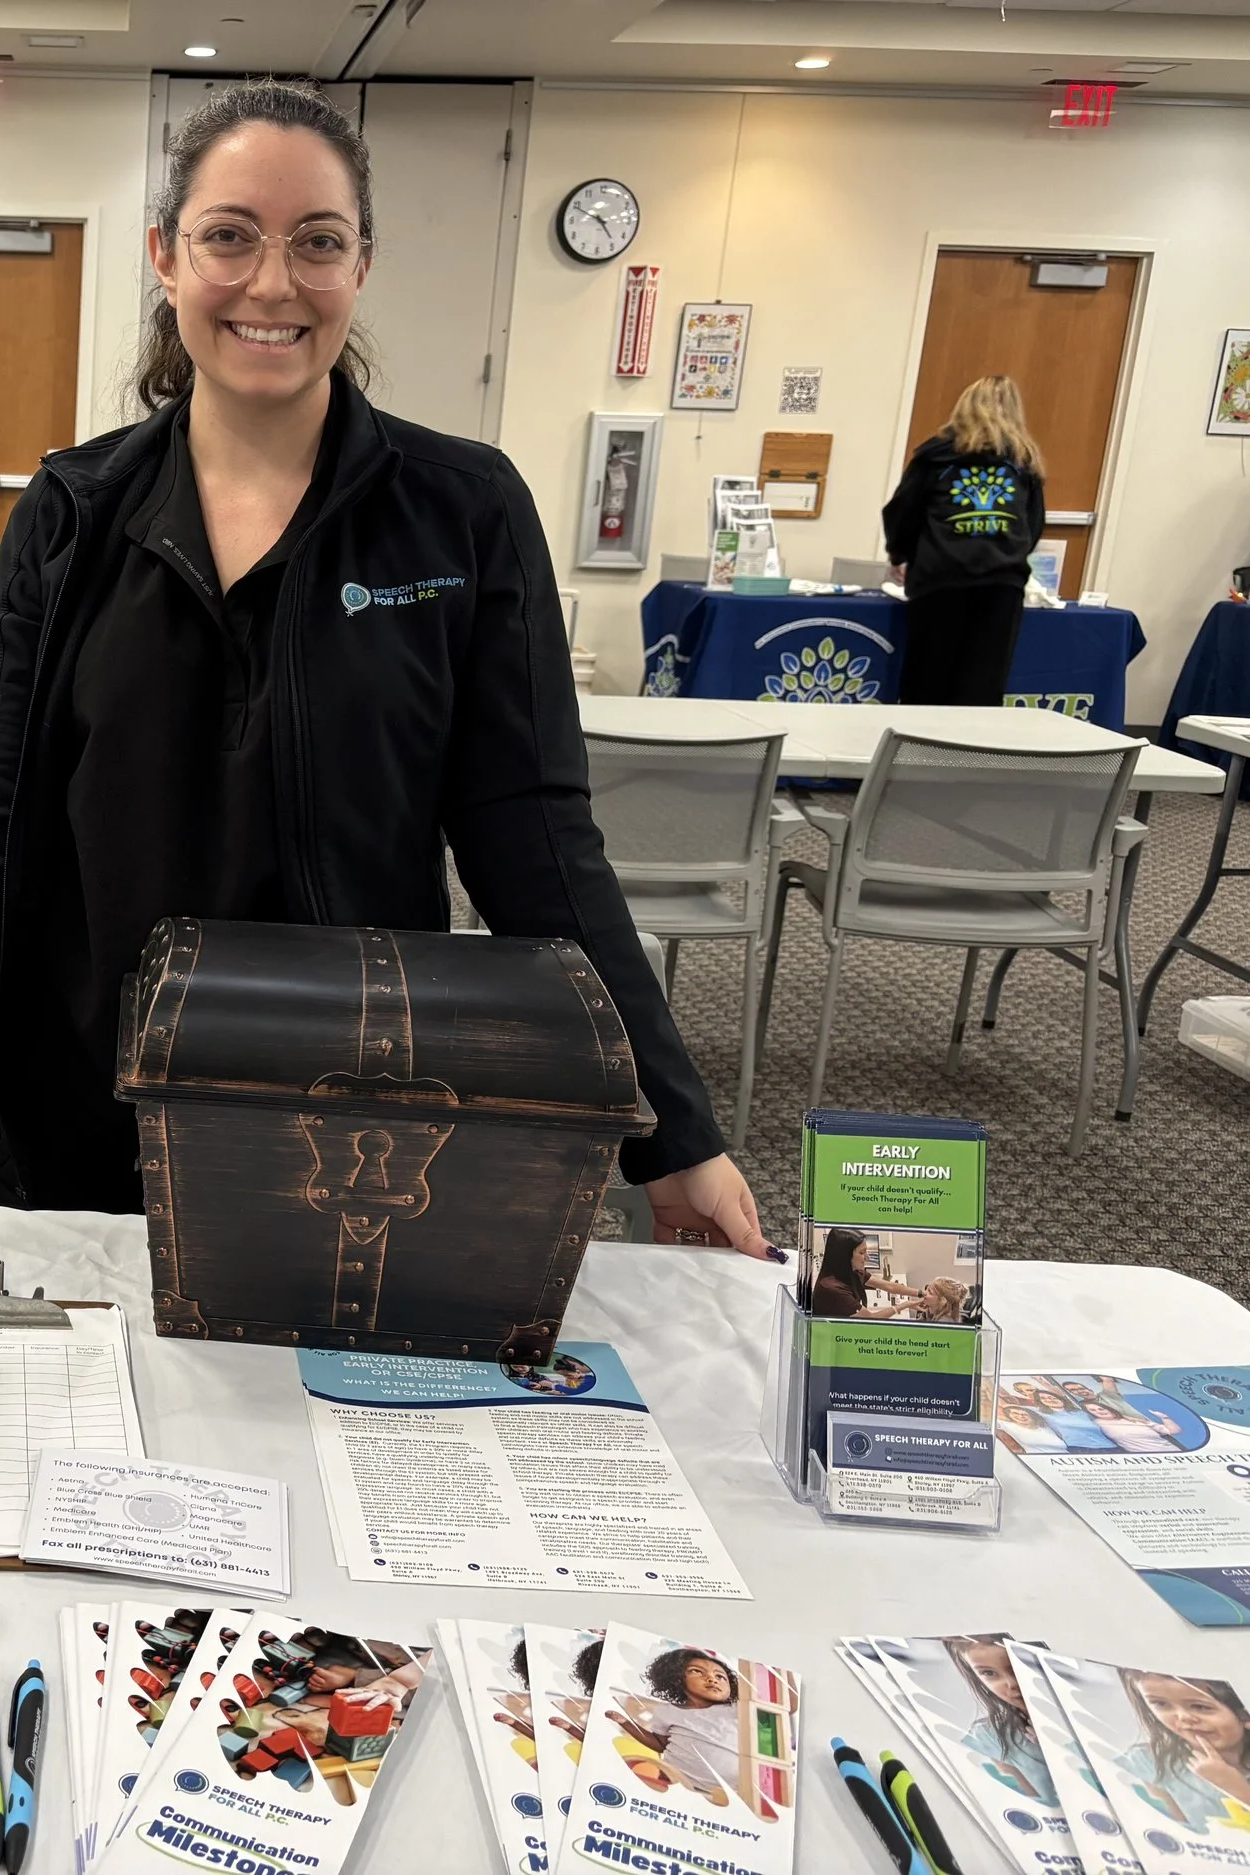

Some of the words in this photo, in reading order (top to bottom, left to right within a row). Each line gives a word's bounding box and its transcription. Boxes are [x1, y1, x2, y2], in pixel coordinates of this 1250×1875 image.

[1060, 85, 1119, 127] EXIT
[954, 519, 1010, 533] STRIVE
[372, 585, 413, 598] SPEECH
[415, 577, 466, 593] THERAPY
[373, 596, 395, 606] FOR
[396, 594, 417, 606] ALL
[417, 589, 439, 601] P.C.
[872, 1144, 921, 1159] EARLY
[842, 1161, 952, 1180] INTERVENTION
[866, 1184, 885, 1192] child
[886, 1186, 914, 1194] doesn't
[915, 1187, 952, 1197] qualify...
[342, 1361, 386, 1370] EARLY
[387, 1363, 488, 1376] INTERVENTION
[350, 1355, 407, 1364] PRIVATE
[407, 1358, 478, 1369] PRACTICE,
[371, 1369, 391, 1377] OR
[396, 1371, 463, 1381] CSE/CPSE
[342, 1378, 378, 1386] WHAT
[395, 1381, 417, 1389] THE
[418, 1383, 498, 1393] DIFFERENCE?
[430, 1391, 465, 1399] HELP!
[330, 1408, 358, 1416] WHY
[361, 1410, 412, 1419] CHOOSE
[414, 1413, 436, 1421] US?
[1049, 1456, 1120, 1466] AUTISM
[1122, 1455, 1163, 1466] AND
[1163, 1454, 1237, 1465] SPEECH
[53, 1460, 74, 1468] The
[75, 1462, 126, 1475] following
[128, 1468, 190, 1482] insurances
[190, 1478, 211, 1487] are
[211, 1481, 271, 1497] accepted:
[55, 1497, 87, 1505] NYSHIP
[56, 1486, 76, 1494] Blue
[104, 1491, 124, 1499] Blue
[125, 1493, 153, 1503] Shield
[190, 1494, 228, 1506] Humana
[230, 1499, 262, 1510] TriCare
[53, 1507, 97, 1516] Medicare
[190, 1503, 217, 1513] Cigna
[189, 1513, 243, 1528] Magnacare
[189, 1524, 210, 1532] UMR
[41, 1539, 64, 1549] Fax
[66, 1541, 83, 1551] all
[84, 1544, 169, 1562] prescriptions
[170, 1554, 189, 1565] to:
[190, 1557, 218, 1569] (631)
[220, 1562, 271, 1577] 881-4413
[208, 1793, 236, 1808] FOR
[237, 1804, 262, 1818] ALL
[264, 1812, 290, 1826] P.C.
[211, 1785, 266, 1809] SPEECH
[268, 1803, 332, 1826] THERAPY
[159, 1805, 320, 1868] Communication
